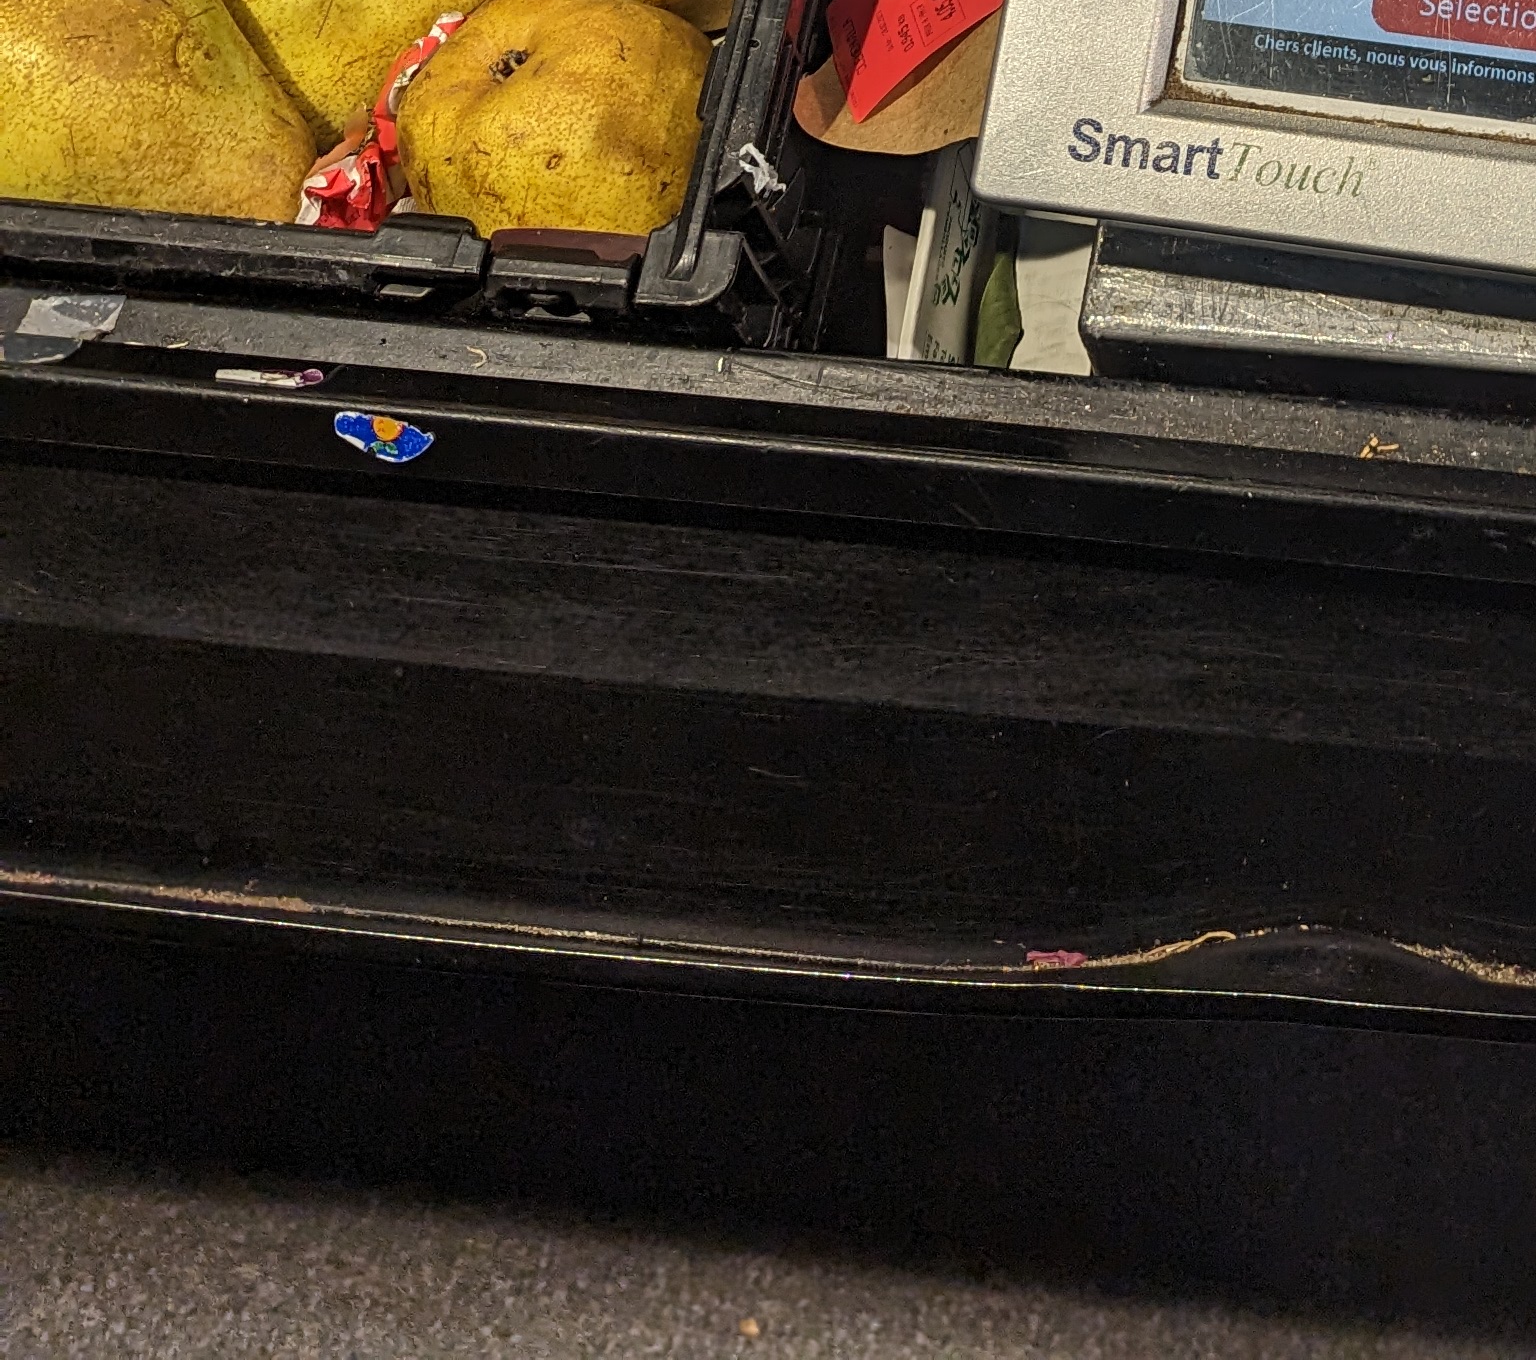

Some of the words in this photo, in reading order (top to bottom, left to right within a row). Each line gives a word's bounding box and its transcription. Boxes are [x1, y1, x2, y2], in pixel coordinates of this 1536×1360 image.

[1253, 33, 1301, 53] Chers
[1366, 51, 1405, 67] nous
[1409, 56, 1448, 72] vous
[1449, 59, 1535, 85] informons
[1066, 116, 1225, 179] Smart
[1226, 141, 1365, 198] Touch
